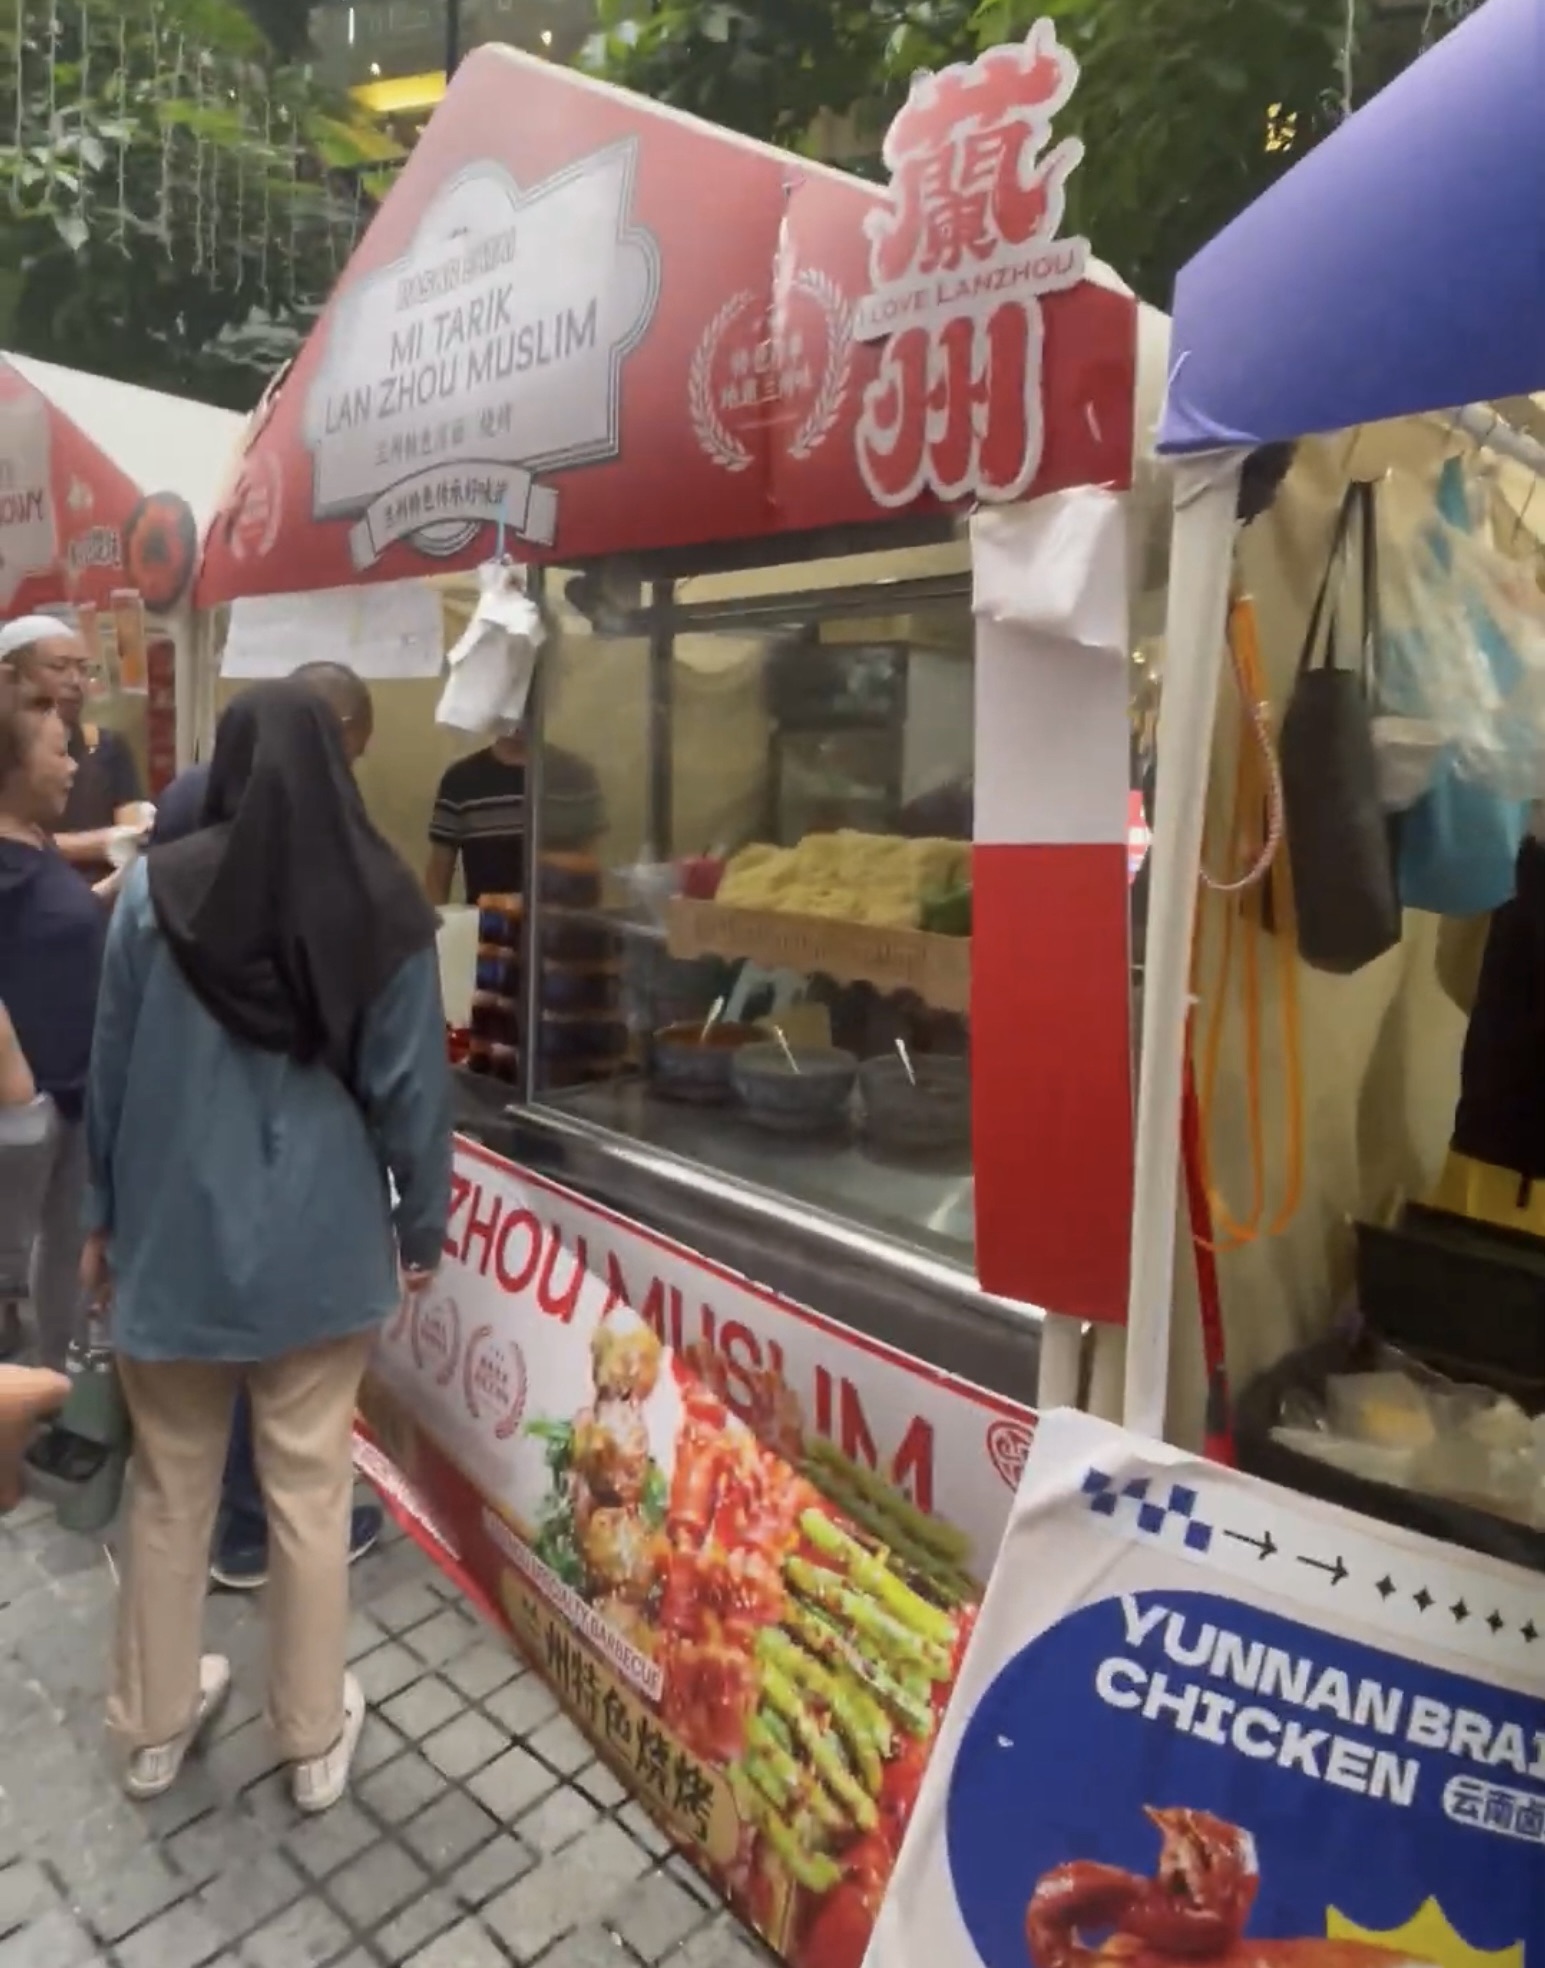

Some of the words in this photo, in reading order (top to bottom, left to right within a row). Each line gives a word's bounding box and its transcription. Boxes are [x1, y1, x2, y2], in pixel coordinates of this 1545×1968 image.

[390, 320, 424, 371] MI
[434, 283, 513, 353] TARIK
[871, 289, 928, 324] LOVE
[936, 248, 1075, 306] LANZHOU
[325, 384, 371, 435] LAN
[378, 354, 458, 418] ZHOU
[466, 296, 598, 391] MUSLIM
[1095, 1658, 1421, 1808] CHICKEN
[1116, 1593, 1404, 1735] YUNNAN
